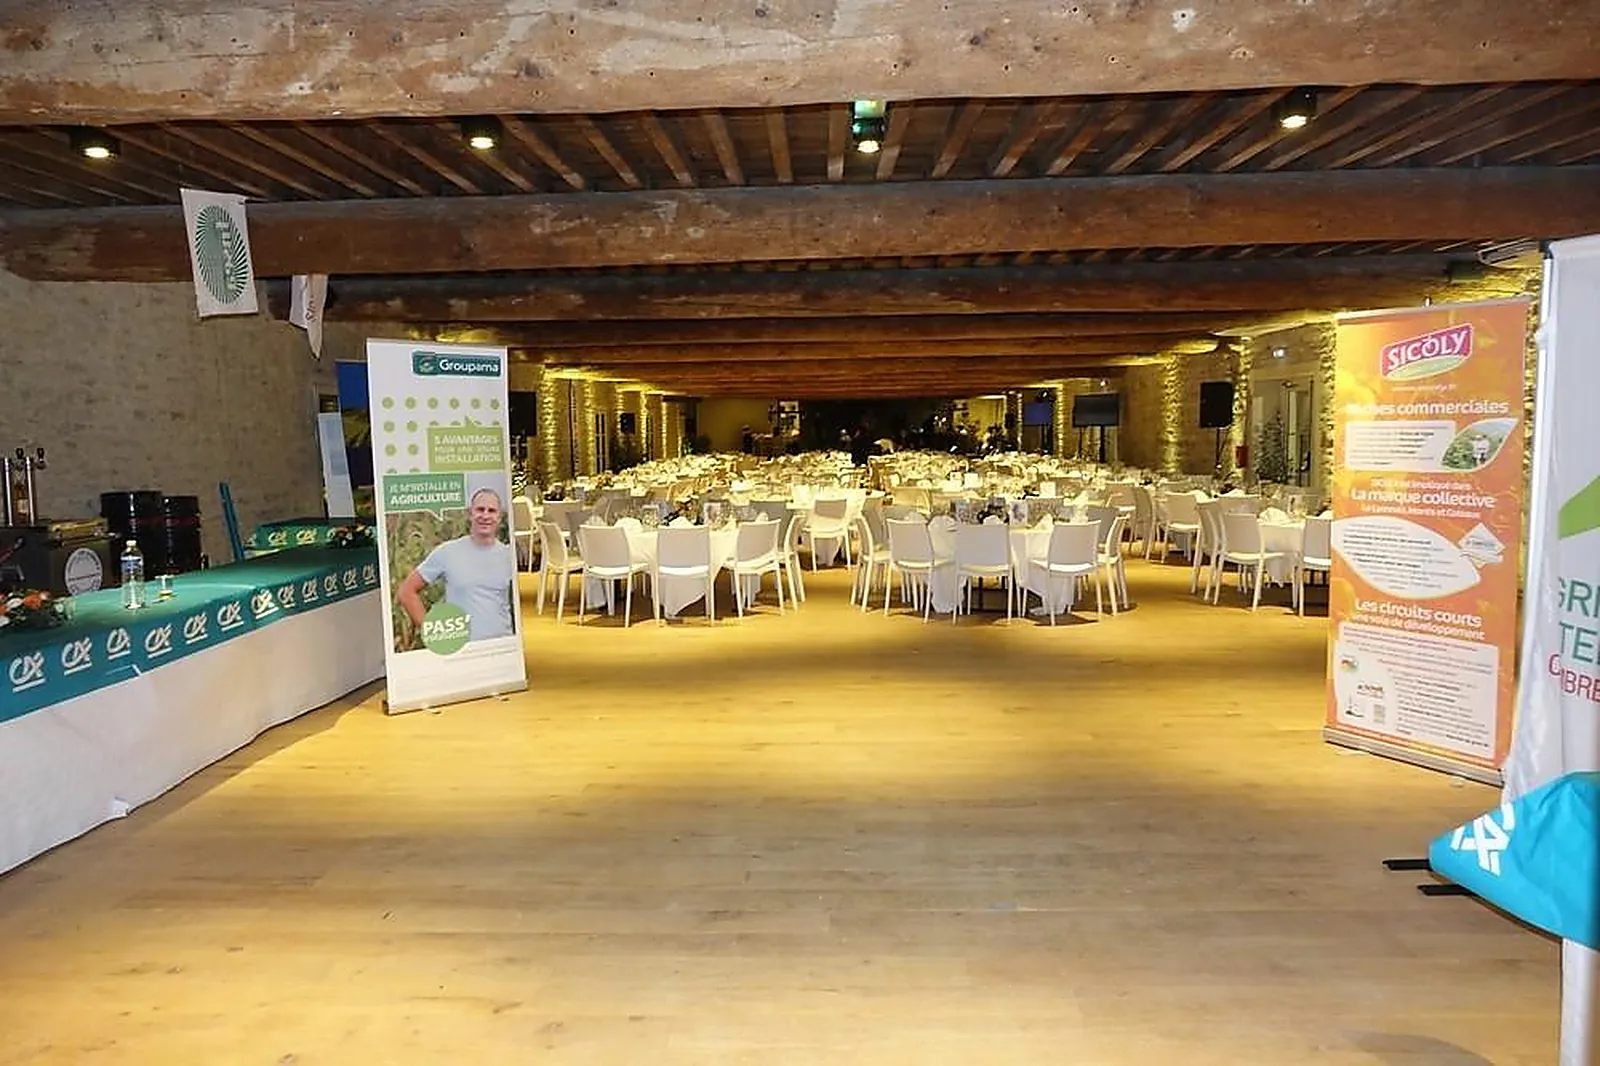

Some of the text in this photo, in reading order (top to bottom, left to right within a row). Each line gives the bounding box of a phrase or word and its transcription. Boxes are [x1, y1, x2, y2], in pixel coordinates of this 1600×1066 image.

[1386, 330, 1468, 370] SICOLY
[439, 358, 499, 373] Groupama
[1397, 399, 1509, 415] commerciales
[434, 454, 501, 463] INSTALLATION
[391, 492, 462, 505] AGRICULTURE
[1351, 487, 1497, 508] La marque collective
[1355, 598, 1482, 627] Les circuits courts
